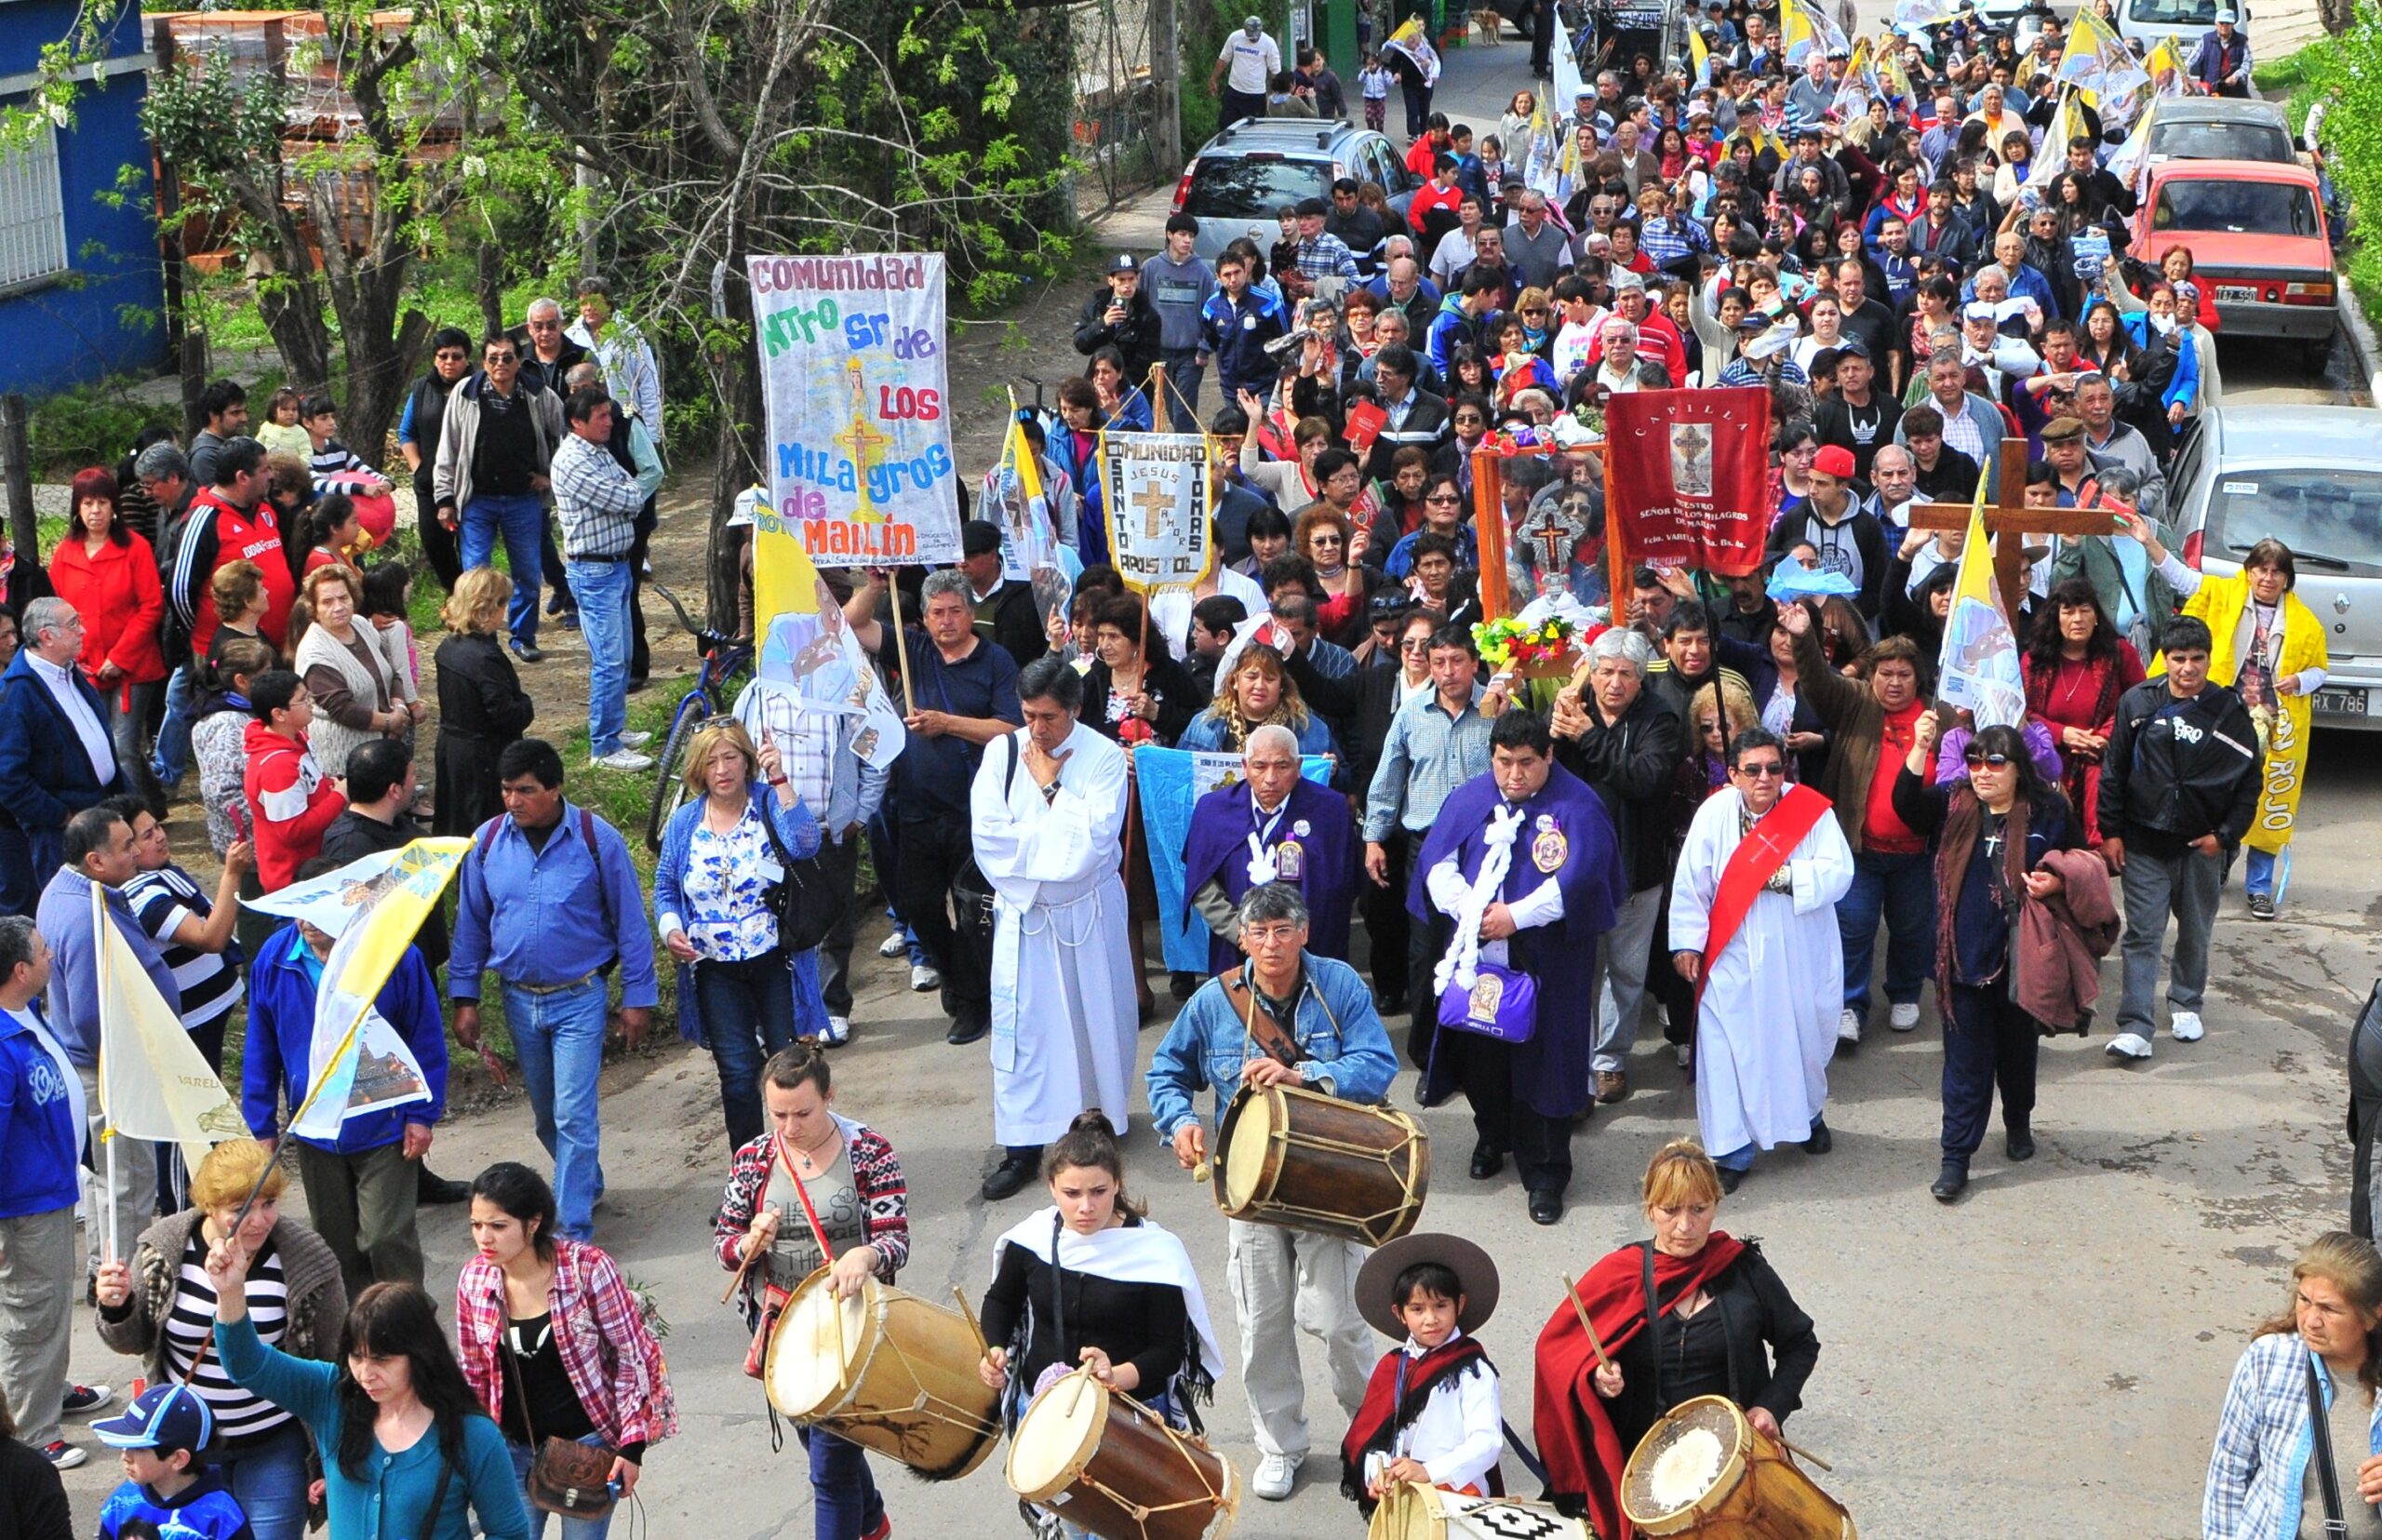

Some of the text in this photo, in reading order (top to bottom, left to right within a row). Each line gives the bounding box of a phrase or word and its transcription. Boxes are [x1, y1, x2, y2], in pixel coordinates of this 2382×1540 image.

[844, 312, 890, 350] Sr
[893, 326, 937, 361] de
[879, 385, 940, 420] LOS
[1635, 404, 1748, 436] CAPILLA
[1105, 440, 1207, 462] COMUNIDAD
[1131, 466, 1180, 484] JESUS
[782, 485, 826, 520] de
[1111, 459, 1129, 550] SANTO
[1188, 462, 1204, 553] TOMAS
[1639, 507, 1671, 518] SEÑOR
[1704, 511, 1748, 521] MILAGROS
[2338, 695, 2365, 713] 786
[2262, 759, 2297, 830] ROJO
